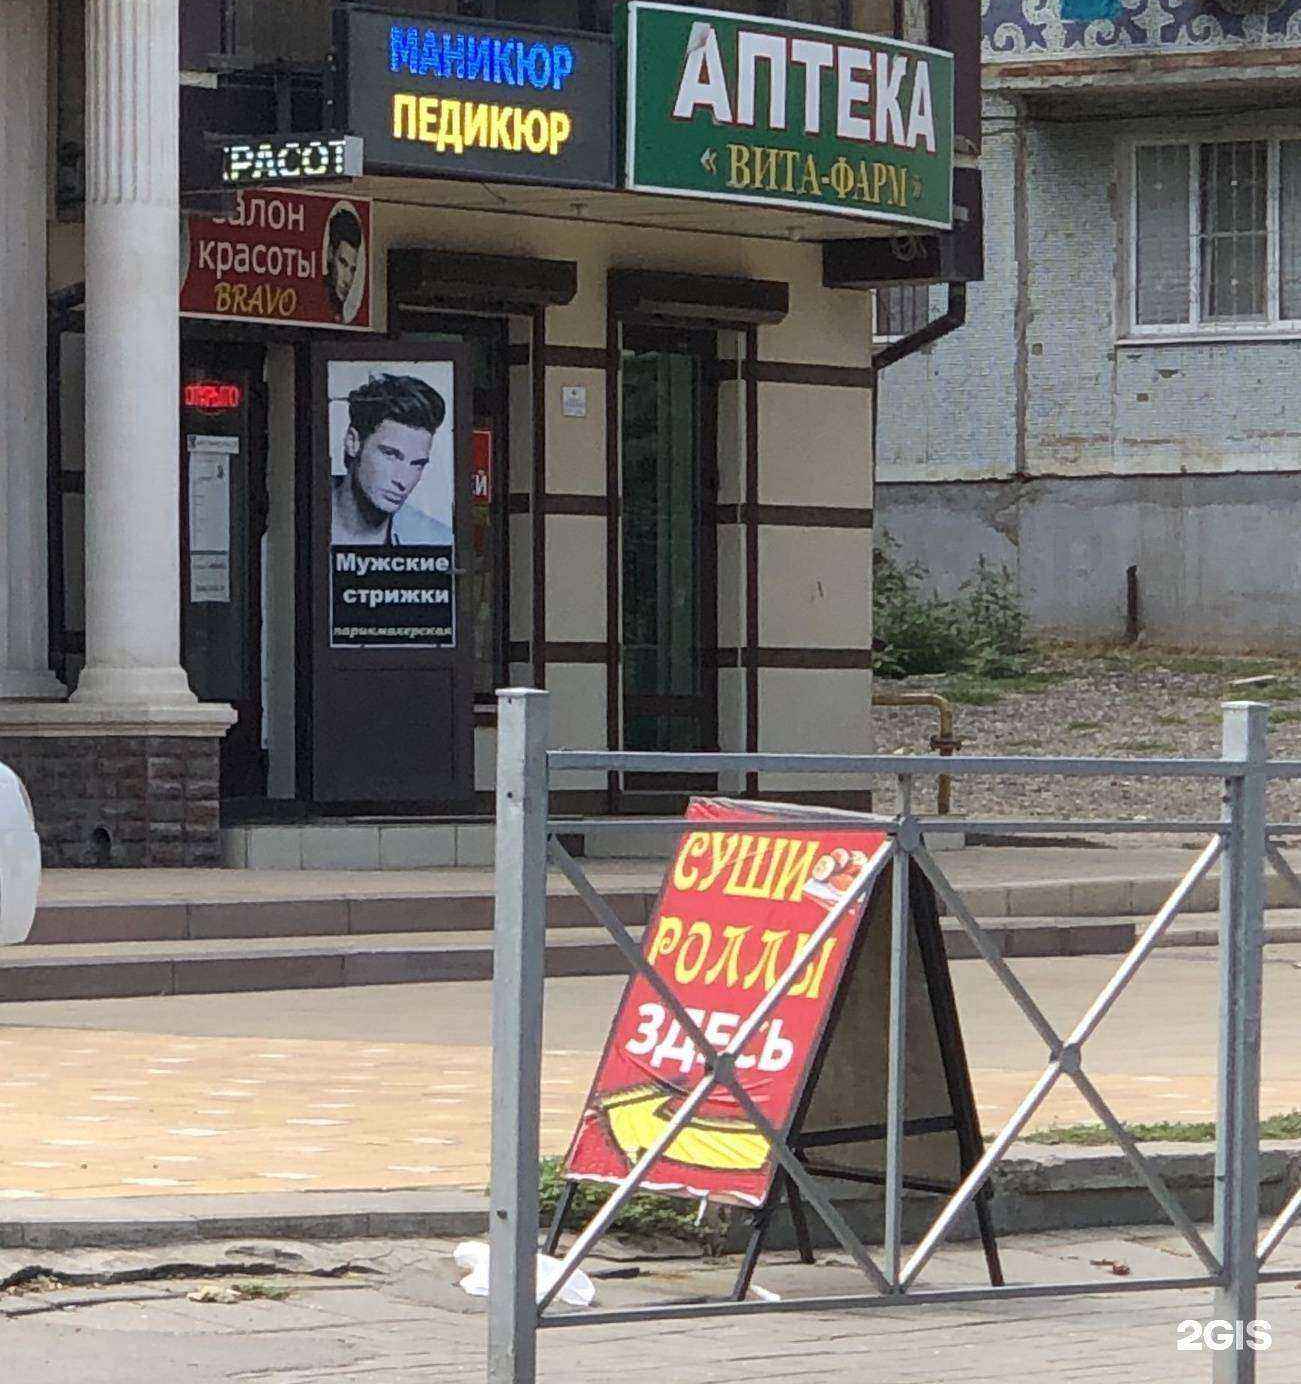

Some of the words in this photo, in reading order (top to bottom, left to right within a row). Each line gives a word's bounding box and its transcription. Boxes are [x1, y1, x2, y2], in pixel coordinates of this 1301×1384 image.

[389, 23, 574, 90] МАНИКЮР
[673, 20, 937, 154] АПТЕКА
[392, 93, 572, 156] ПЕДИКЮР
[199, 240, 316, 279] красоты
[214, 282, 297, 316] BRAVO
[336, 552, 450, 576] Мужские
[342, 589, 449, 608] стрижки
[673, 831, 820, 903] СУШИ
